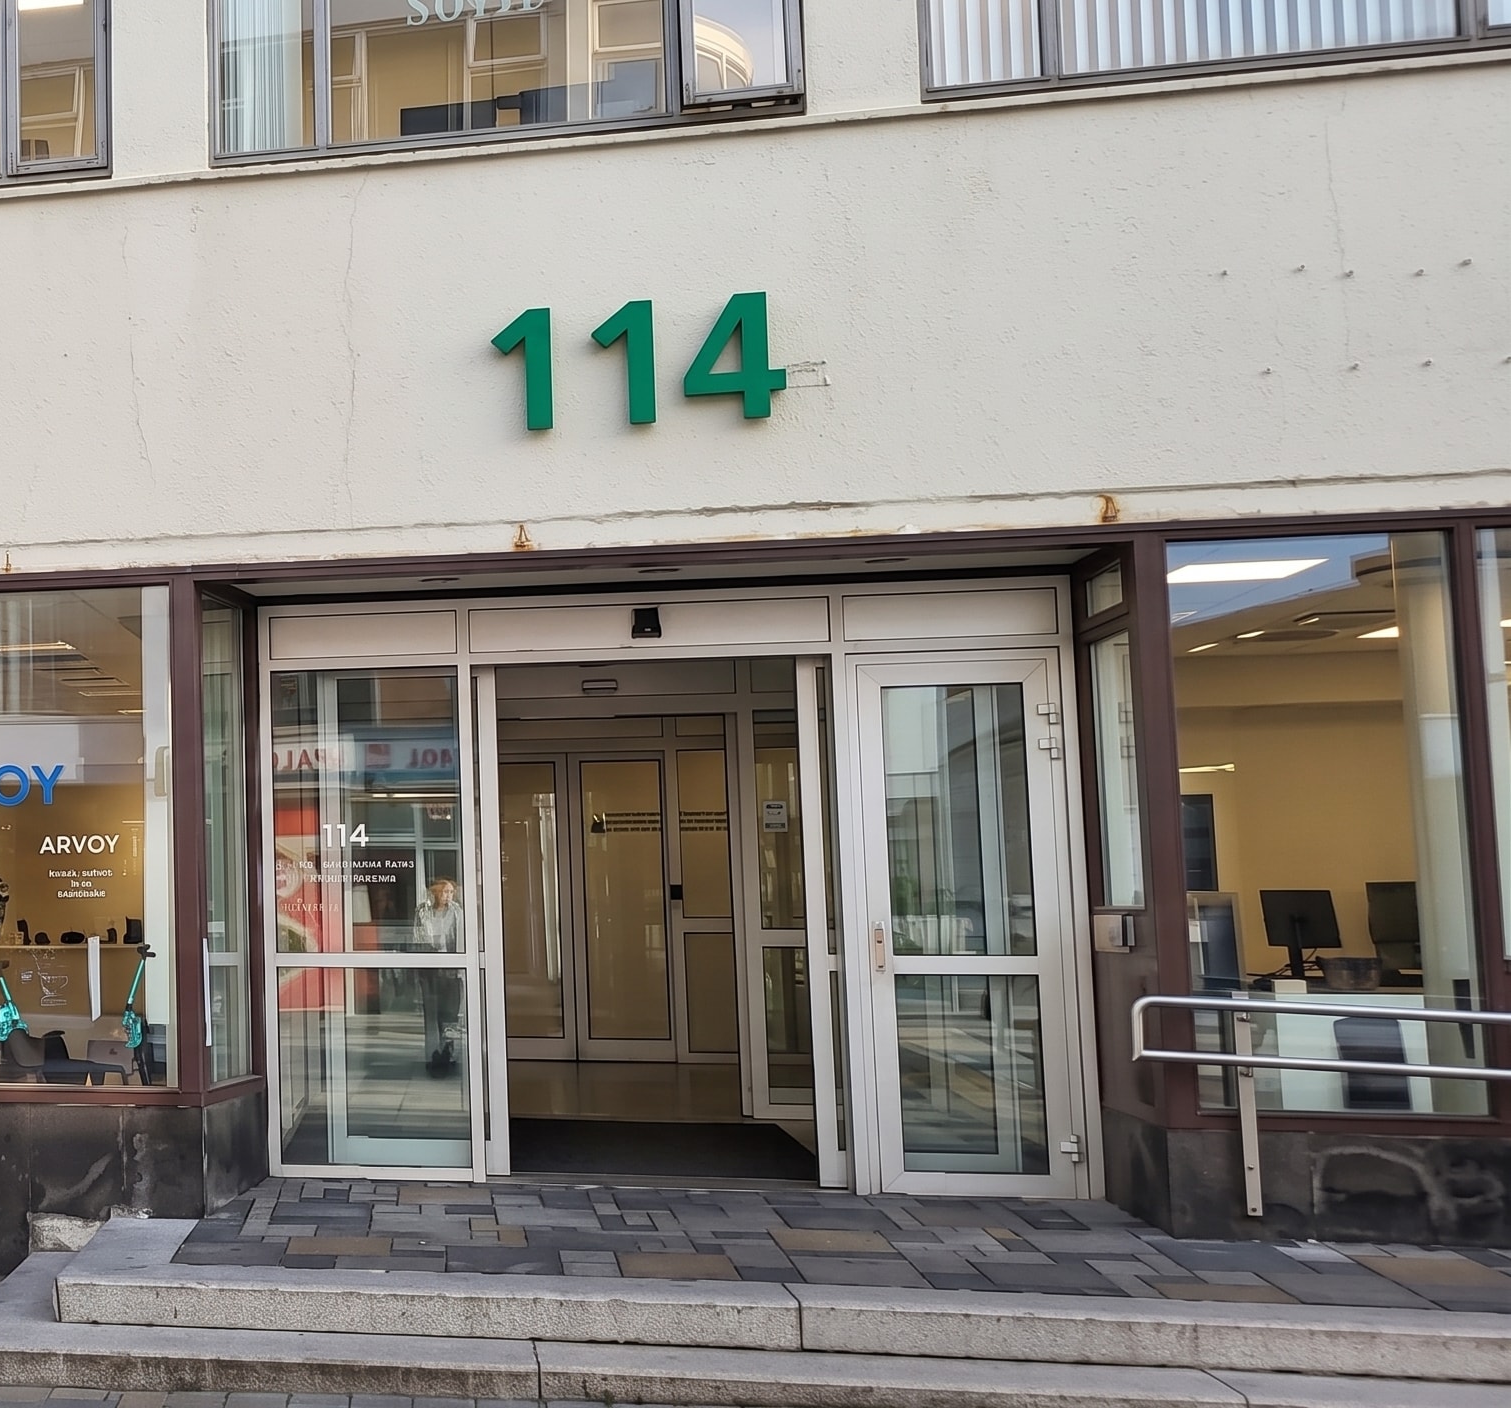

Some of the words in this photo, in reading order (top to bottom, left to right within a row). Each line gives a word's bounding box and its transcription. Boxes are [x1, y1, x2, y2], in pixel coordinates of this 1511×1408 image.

[490, 290, 787, 431] 114
[39, 834, 120, 855] ARVOY
[322, 823, 370, 848] 114
